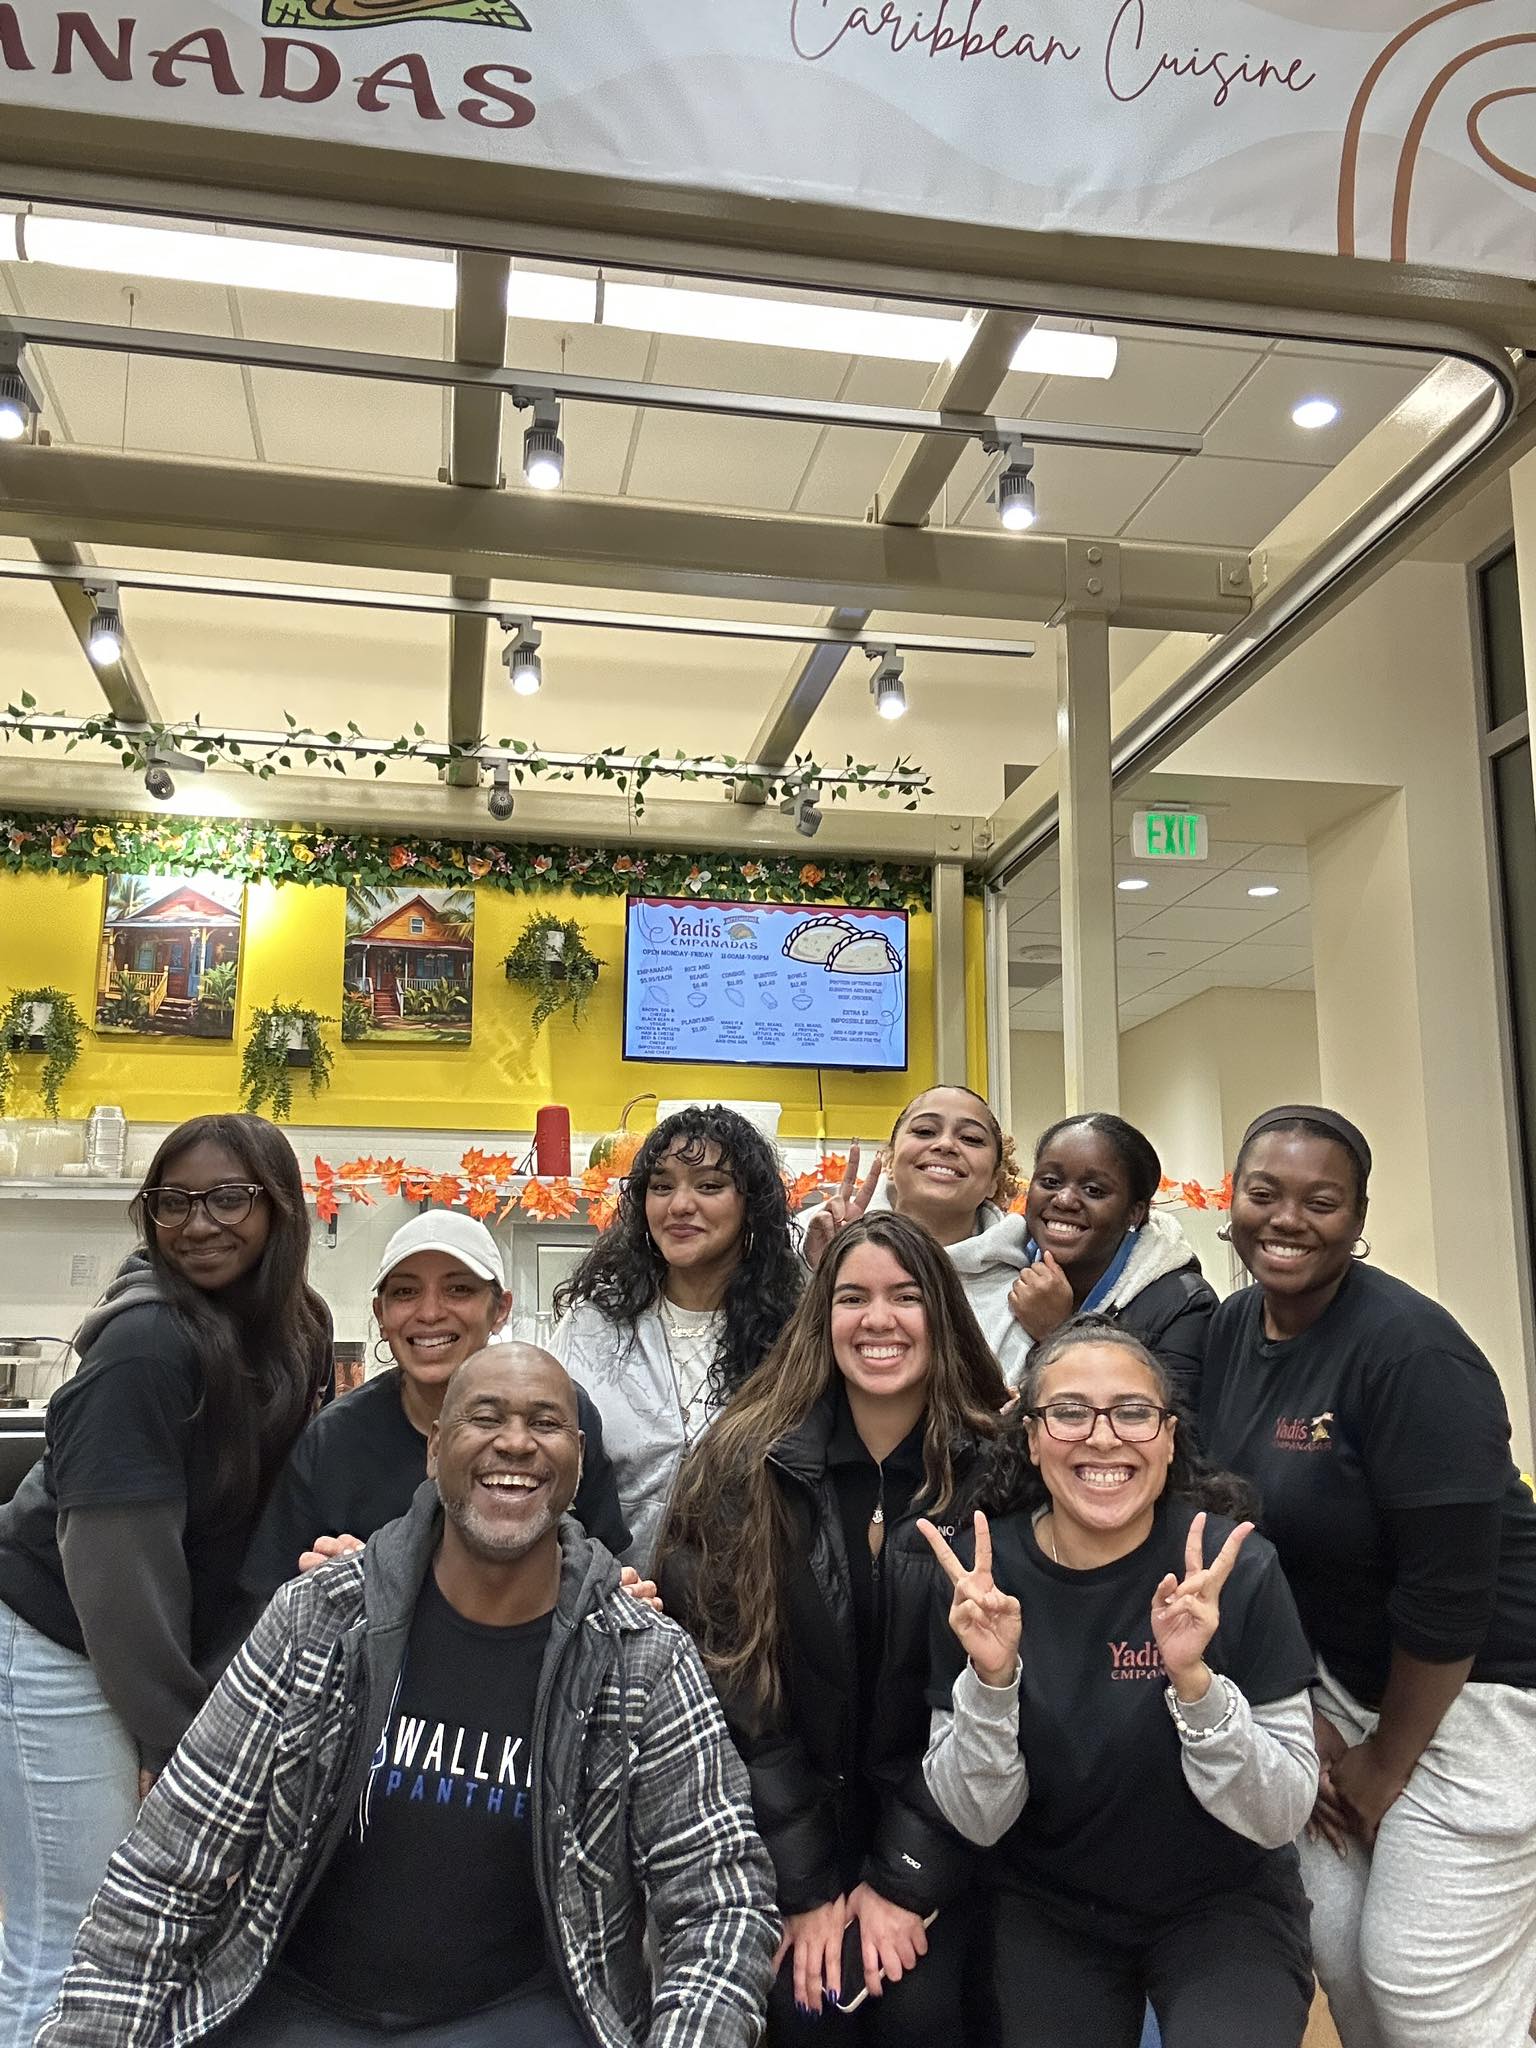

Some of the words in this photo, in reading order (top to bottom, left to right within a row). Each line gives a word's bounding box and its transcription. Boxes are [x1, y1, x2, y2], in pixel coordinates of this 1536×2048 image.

[790, 0, 1081, 66] Caribbean
[1105, 0, 1316, 107] Cuisine
[1146, 814, 1198, 857] EXIT
[668, 916, 721, 938] Yadi's
[670, 938, 758, 950] EMPANADAS
[637, 965, 673, 976] EMPANADAS
[1107, 1641, 1163, 1668] Yadi
[902, 1852, 922, 1869] 700
